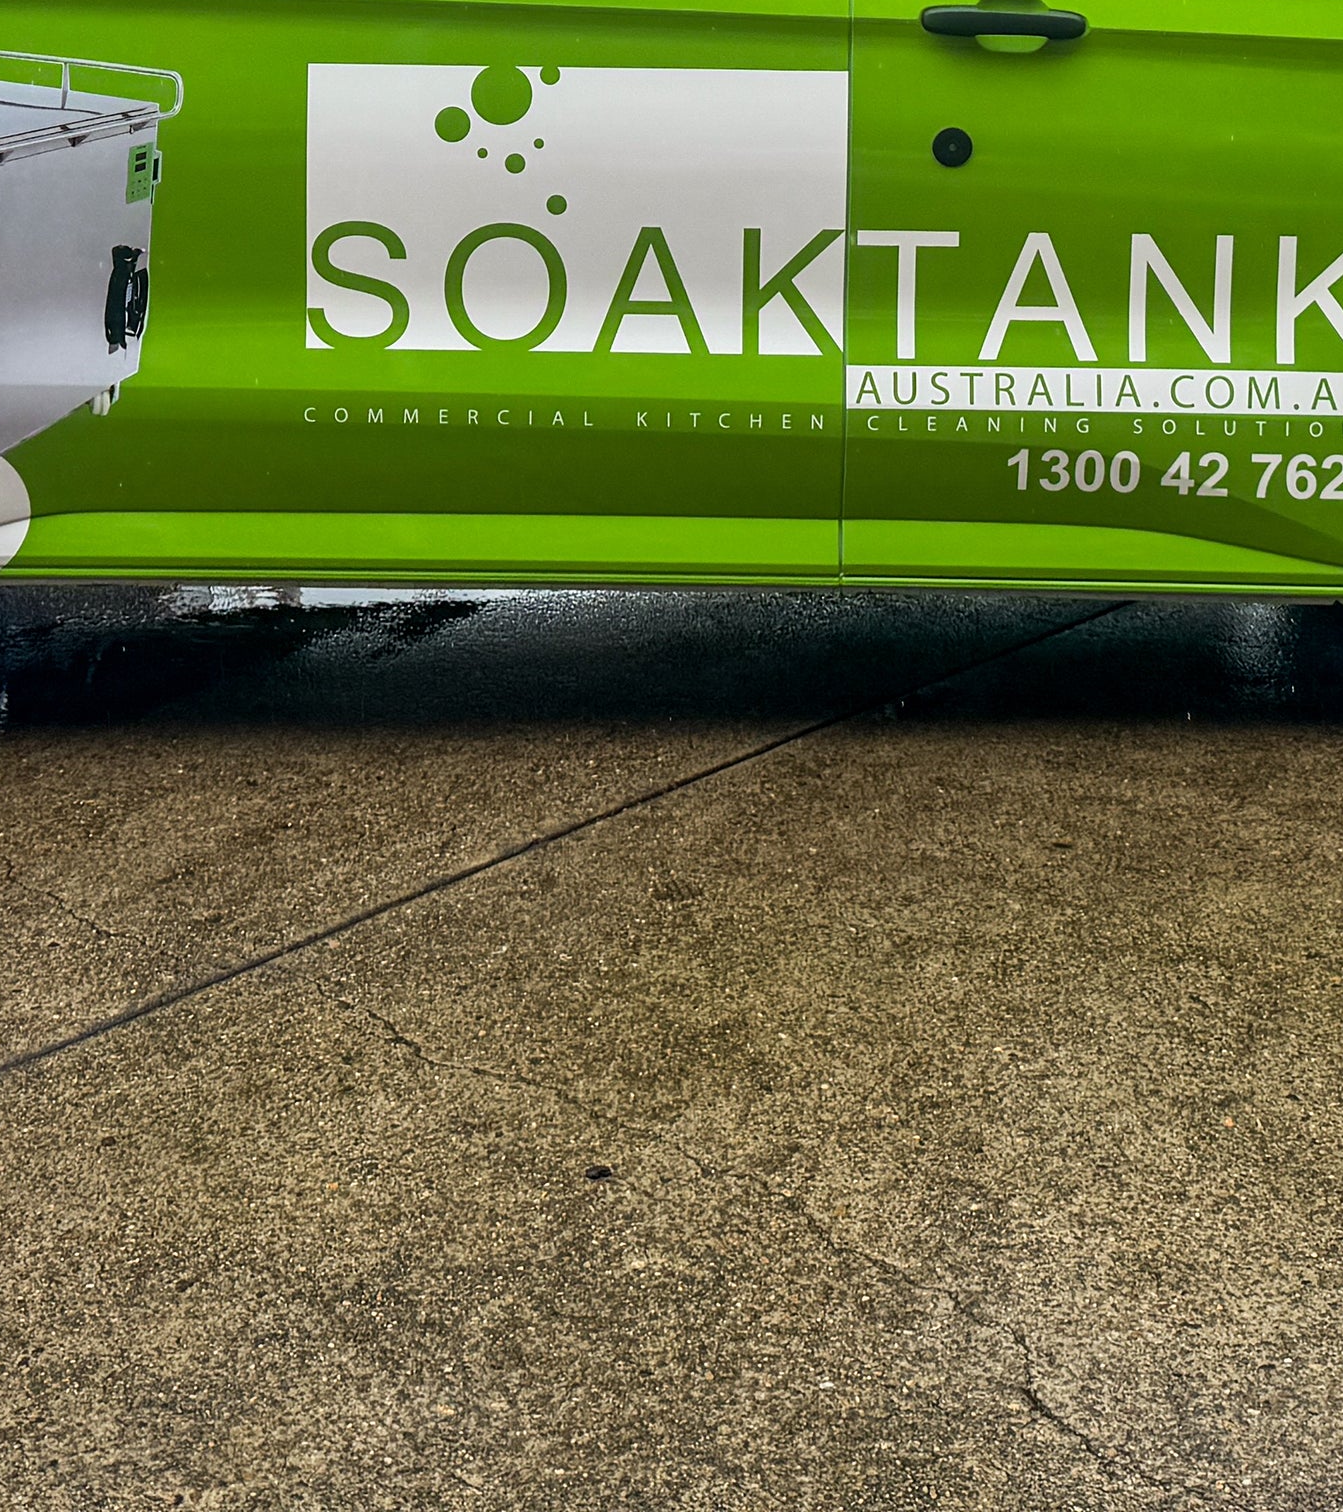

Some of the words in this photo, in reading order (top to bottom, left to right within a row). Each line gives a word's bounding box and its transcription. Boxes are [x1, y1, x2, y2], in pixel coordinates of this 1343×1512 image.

[303, 406, 594, 427] COMMERCIAL
[636, 410, 825, 431] KITCHEN
[867, 414, 1090, 435] CLEANING
[1007, 448, 1141, 493] 1300
[1160, 451, 1229, 497] 42
